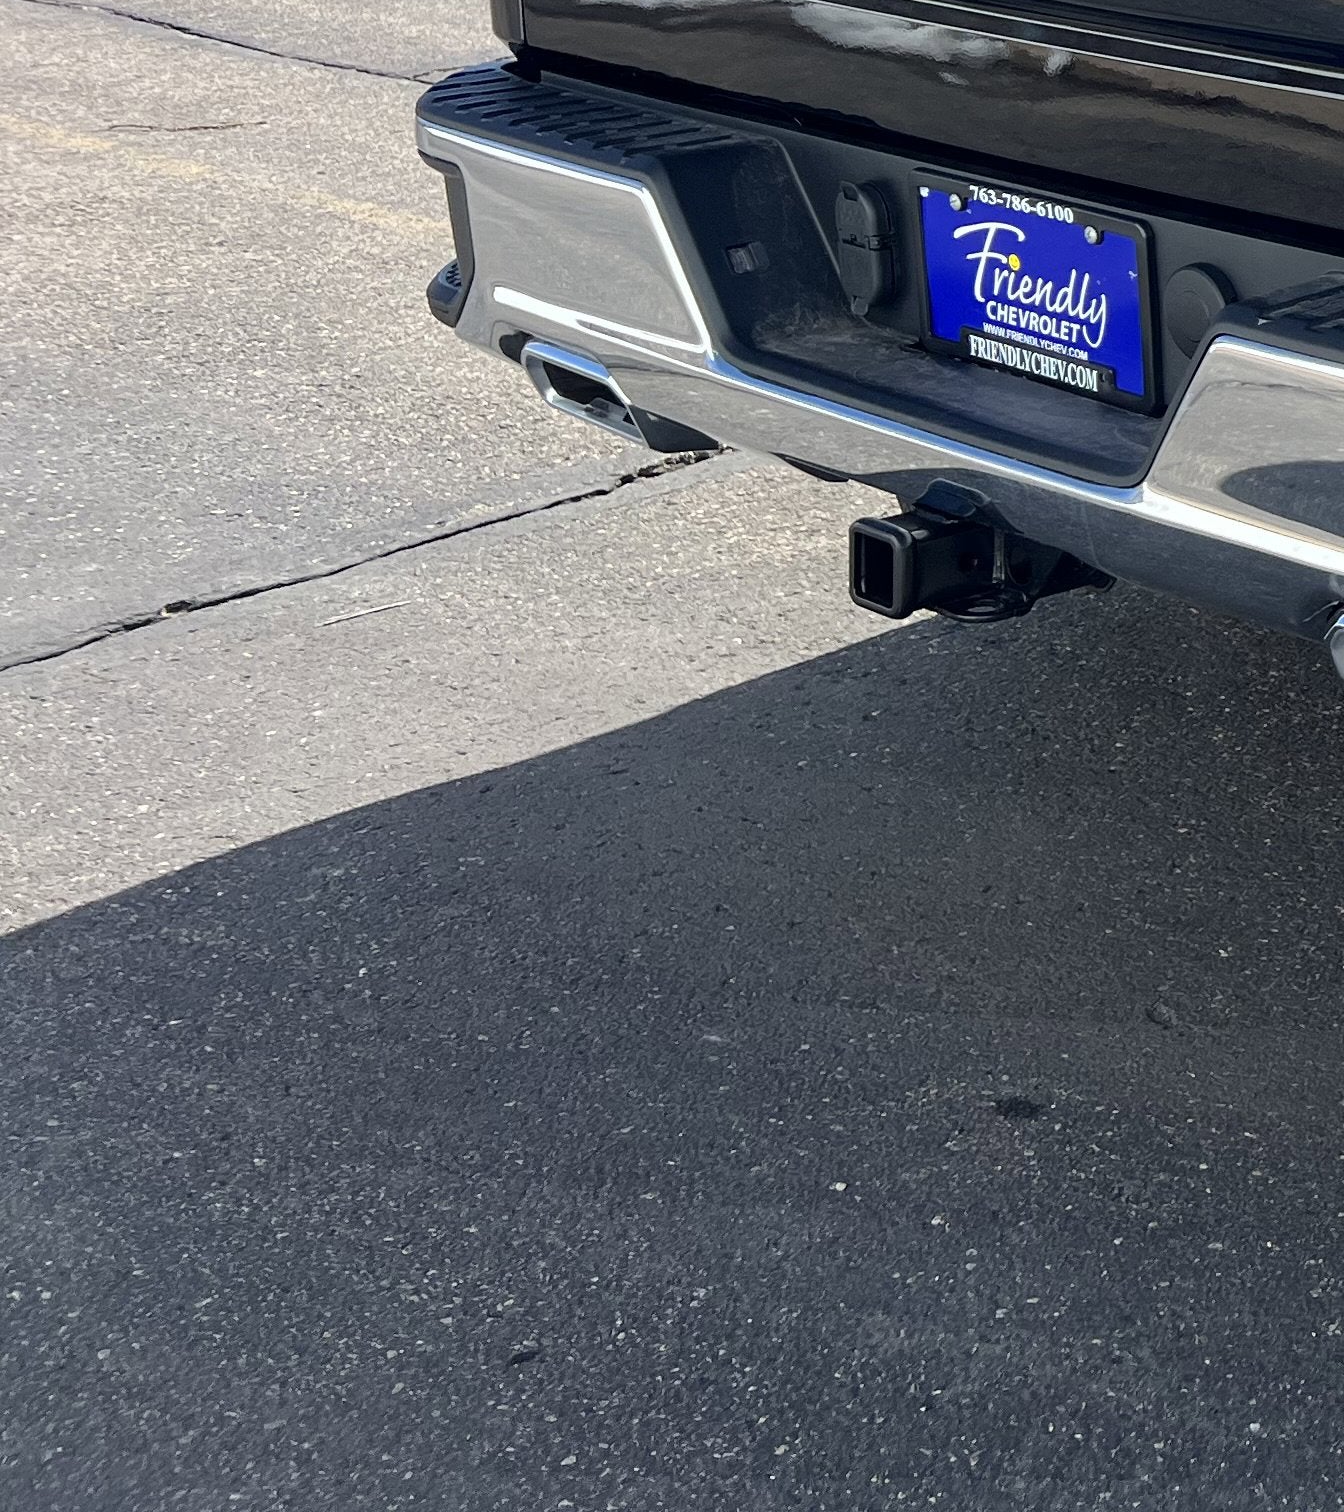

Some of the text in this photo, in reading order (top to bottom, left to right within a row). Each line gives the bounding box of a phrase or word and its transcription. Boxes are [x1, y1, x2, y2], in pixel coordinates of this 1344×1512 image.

[969, 185, 1074, 223] 763-786-6100
[953, 221, 1107, 348] Friendly
[983, 322, 1088, 361] WWW.FRIENDLYCHEV.COM
[986, 301, 1080, 343] CHEVROLET
[969, 335, 1098, 392] FRIENDLYCHEV.COM
